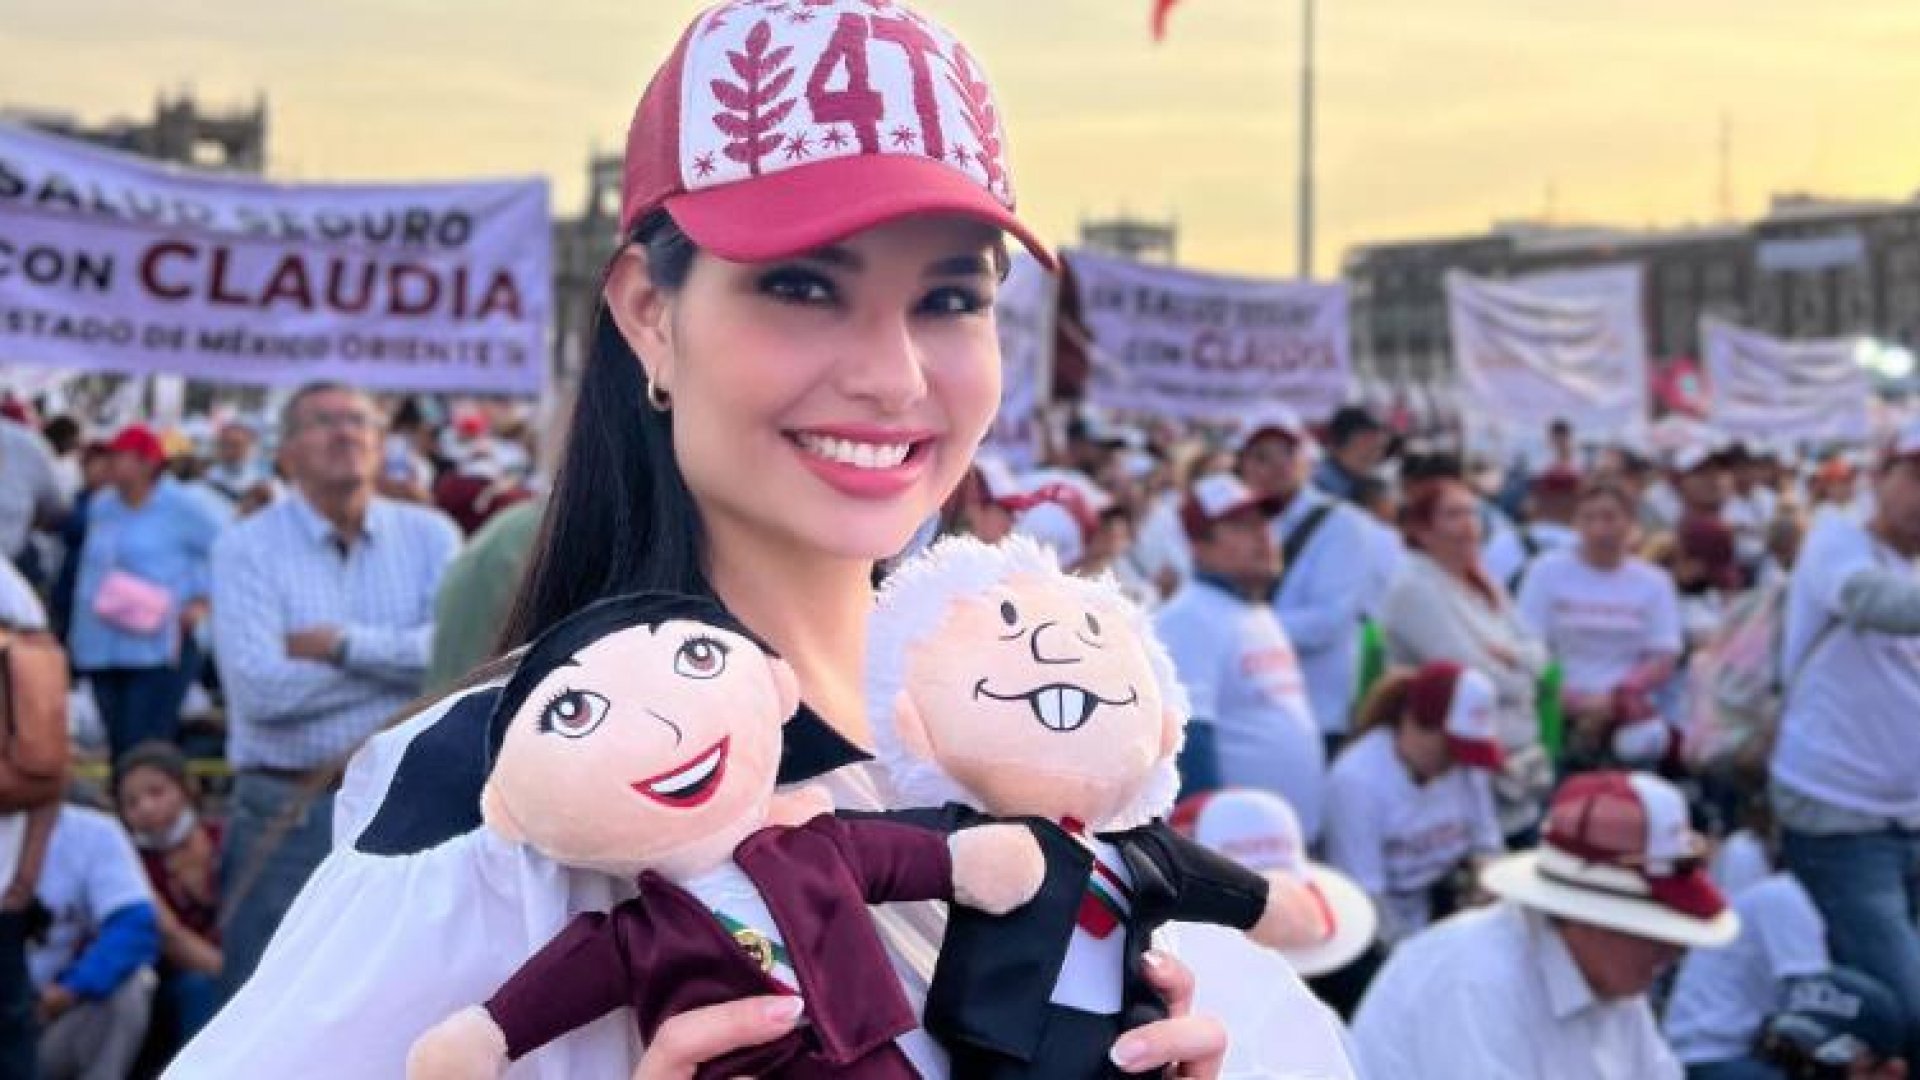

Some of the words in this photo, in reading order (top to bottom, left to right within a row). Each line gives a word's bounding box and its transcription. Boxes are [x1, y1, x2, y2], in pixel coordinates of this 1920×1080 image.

[804, 13, 944, 161] 4T
[140, 240, 524, 322] CLAUDIA
[143, 323, 184, 350] DE
[338, 332, 490, 368] ORIENTE
